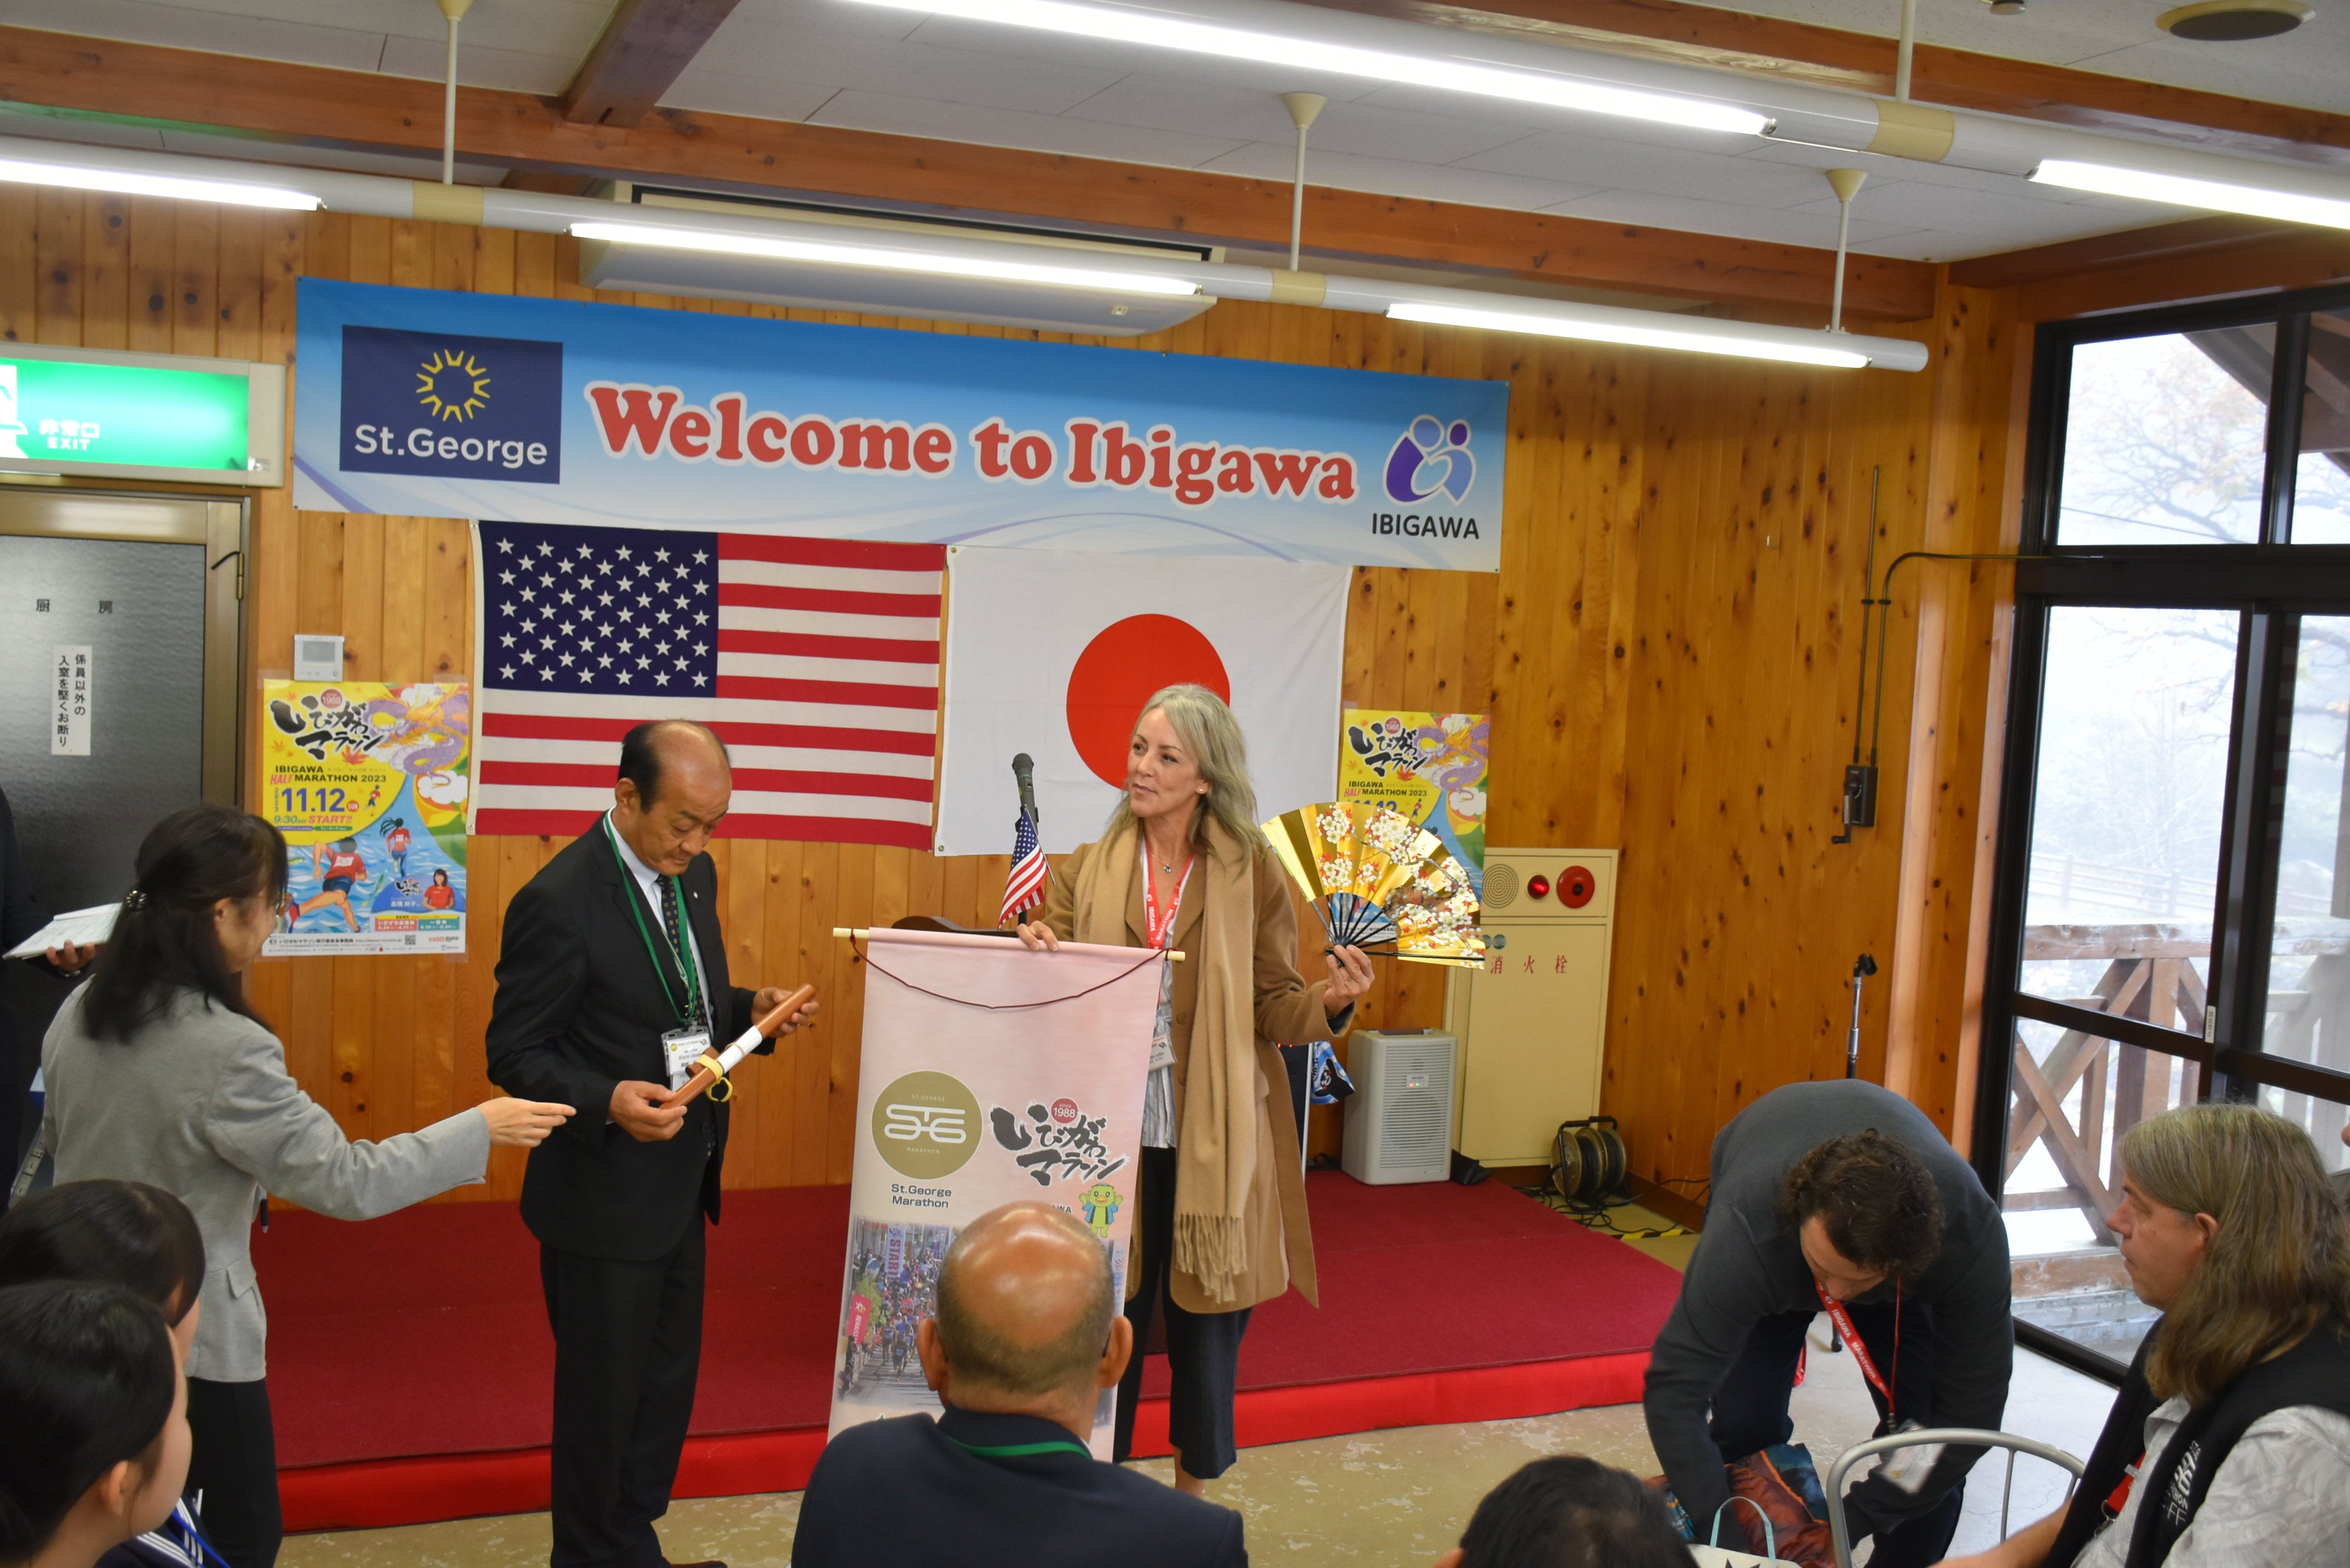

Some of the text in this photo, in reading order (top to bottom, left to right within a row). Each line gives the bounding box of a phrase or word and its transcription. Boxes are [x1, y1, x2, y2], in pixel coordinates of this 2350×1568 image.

[40, 418, 99, 437] 非常口
[48, 437, 89, 450] EXIT
[354, 424, 548, 469] St.George
[589, 386, 1355, 505] Welcome to Ibigawa
[1372, 512, 1480, 540] IBIGAWA
[74, 654, 86, 716] 係員以外の
[57, 655, 70, 747] 入室を堅くお断り
[322, 696, 341, 705] 1988
[270, 774, 294, 785] HALF
[281, 788, 345, 812] 11.12
[1344, 788, 1362, 797] HALF
[1490, 955, 1568, 974] 消火栓
[1053, 1108, 1076, 1118] 1988
[990, 1104, 1107, 1158] いびがわ
[1016, 1148, 1126, 1186] マラソン
[891, 1183, 952, 1197] St.George
[892, 1195, 949, 1208] Marathon
[1831, 1309, 1852, 1338] IBIGAWA
